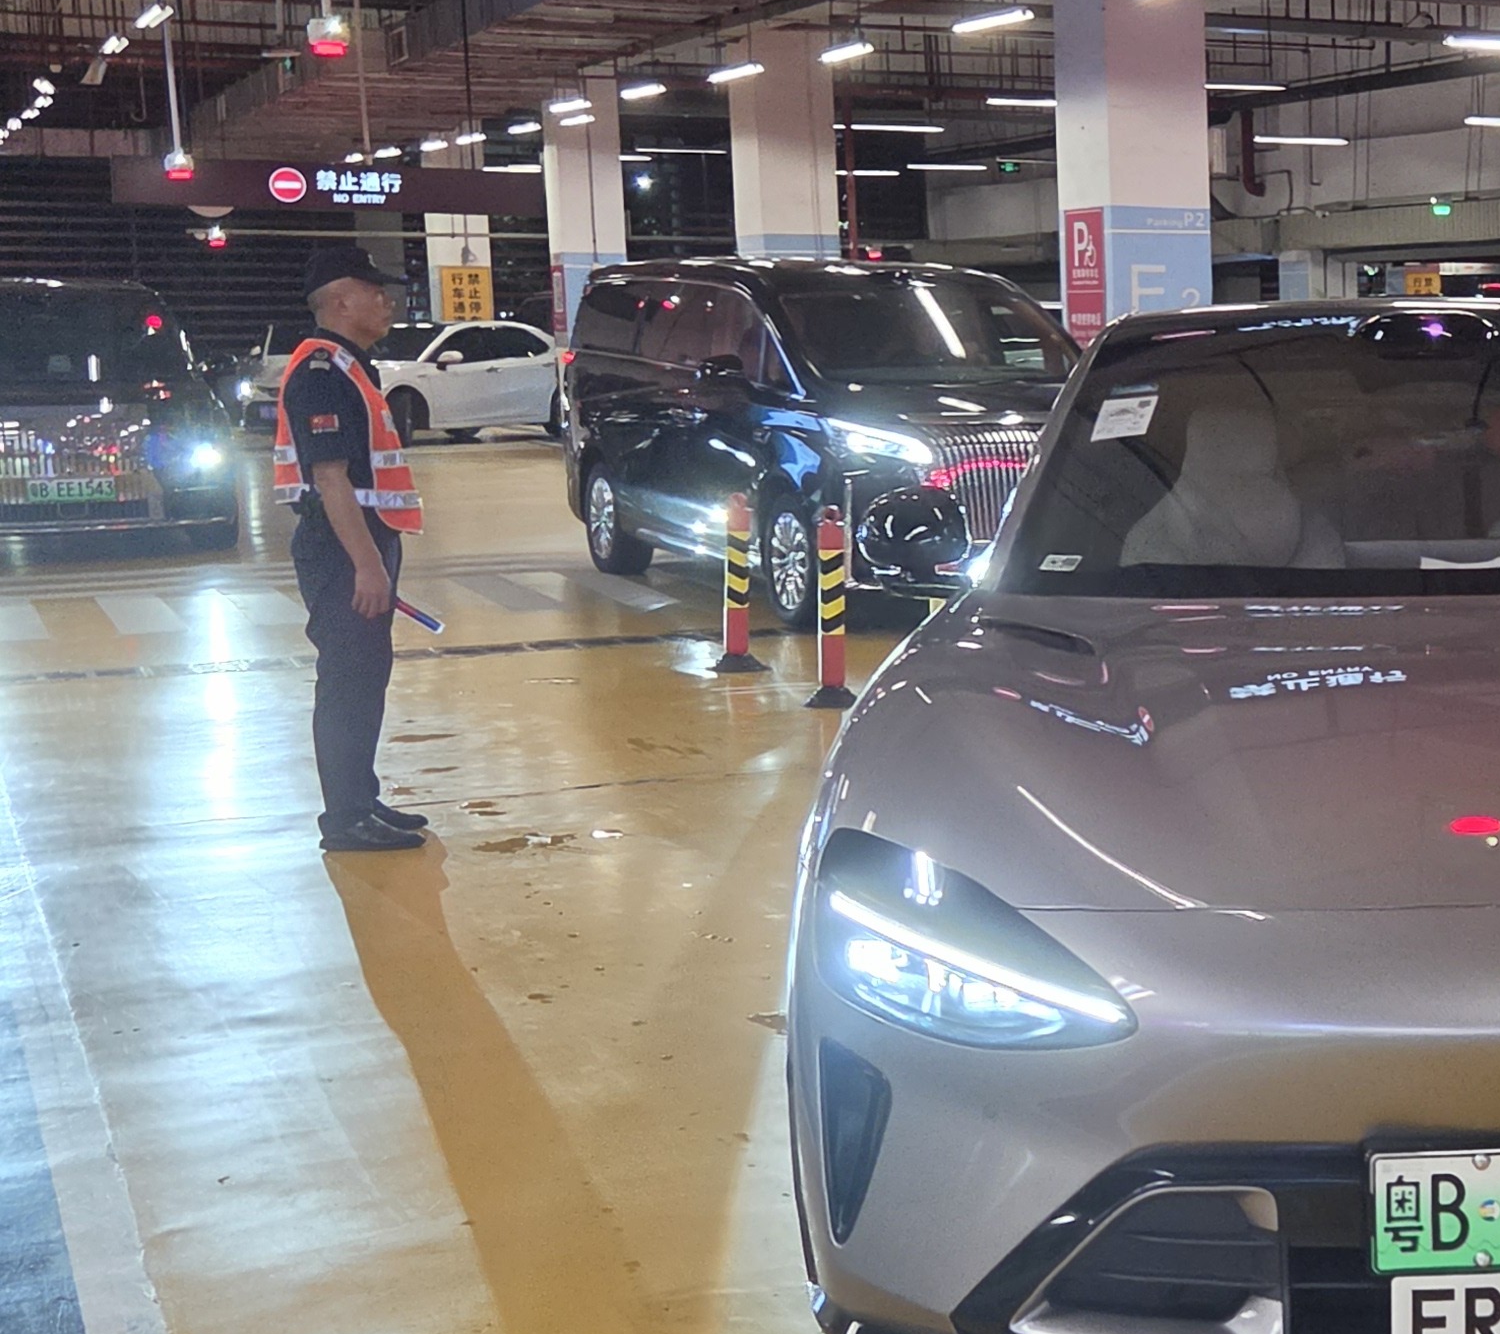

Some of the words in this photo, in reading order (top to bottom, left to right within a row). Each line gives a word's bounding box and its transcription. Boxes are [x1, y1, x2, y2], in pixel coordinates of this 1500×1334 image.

[316, 169, 402, 193] 禁止通行
[333, 193, 349, 203] NO
[352, 193, 386, 204] ENTRY
[1184, 211, 1206, 227] P2
[56, 480, 113, 498] EE1543
[1383, 1174, 1470, 1252] 粤B
